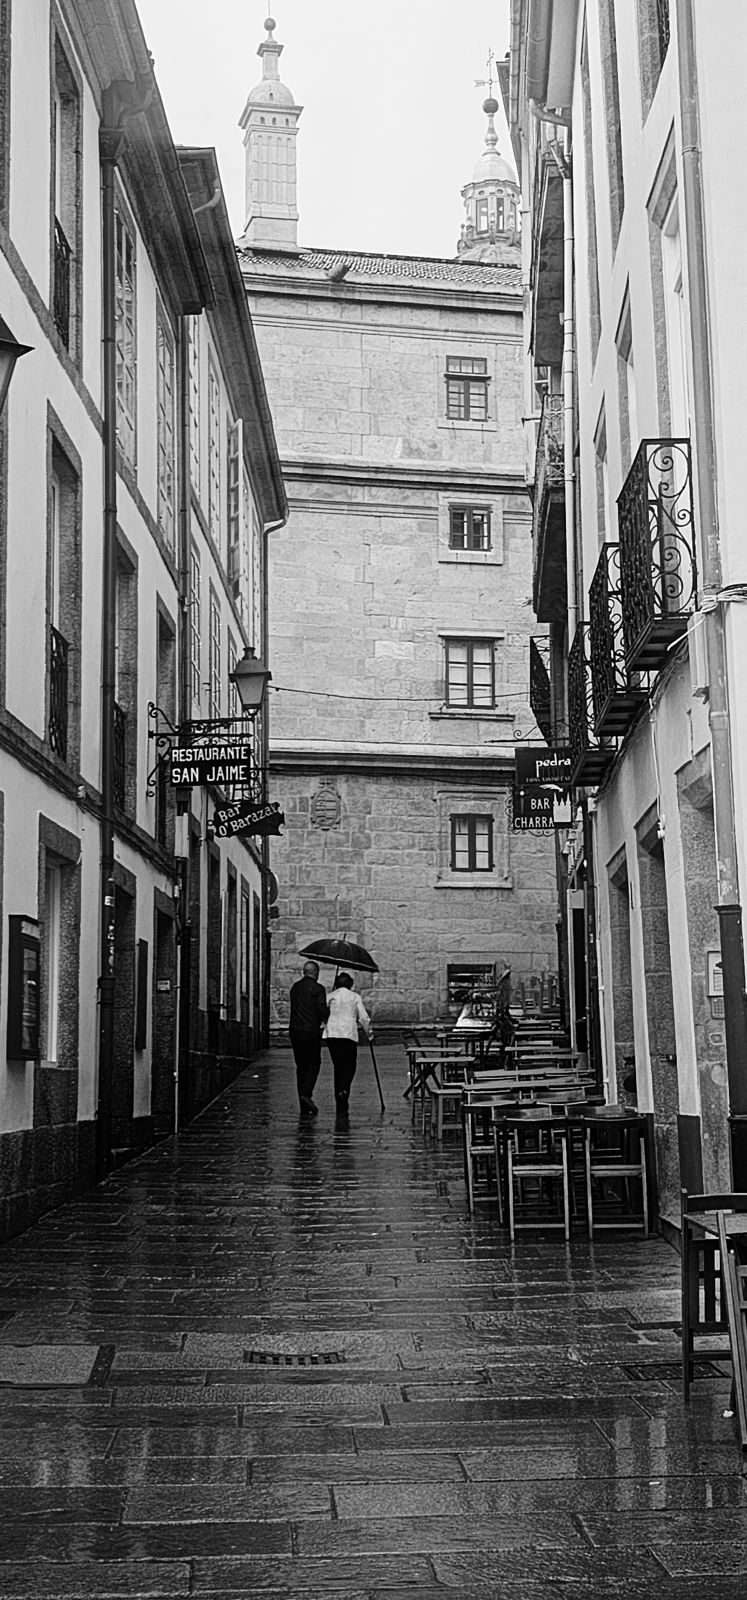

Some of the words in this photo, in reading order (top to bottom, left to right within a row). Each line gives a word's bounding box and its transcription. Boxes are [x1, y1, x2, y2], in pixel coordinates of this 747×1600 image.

[171, 746, 249, 763] RESTAURANTE
[535, 752, 572, 778] pedra
[171, 767, 200, 784] SAN
[206, 765, 248, 782] JAIME
[530, 797, 551, 810] BAR
[217, 804, 242, 823] Bar
[514, 816, 555, 828] CHARRA
